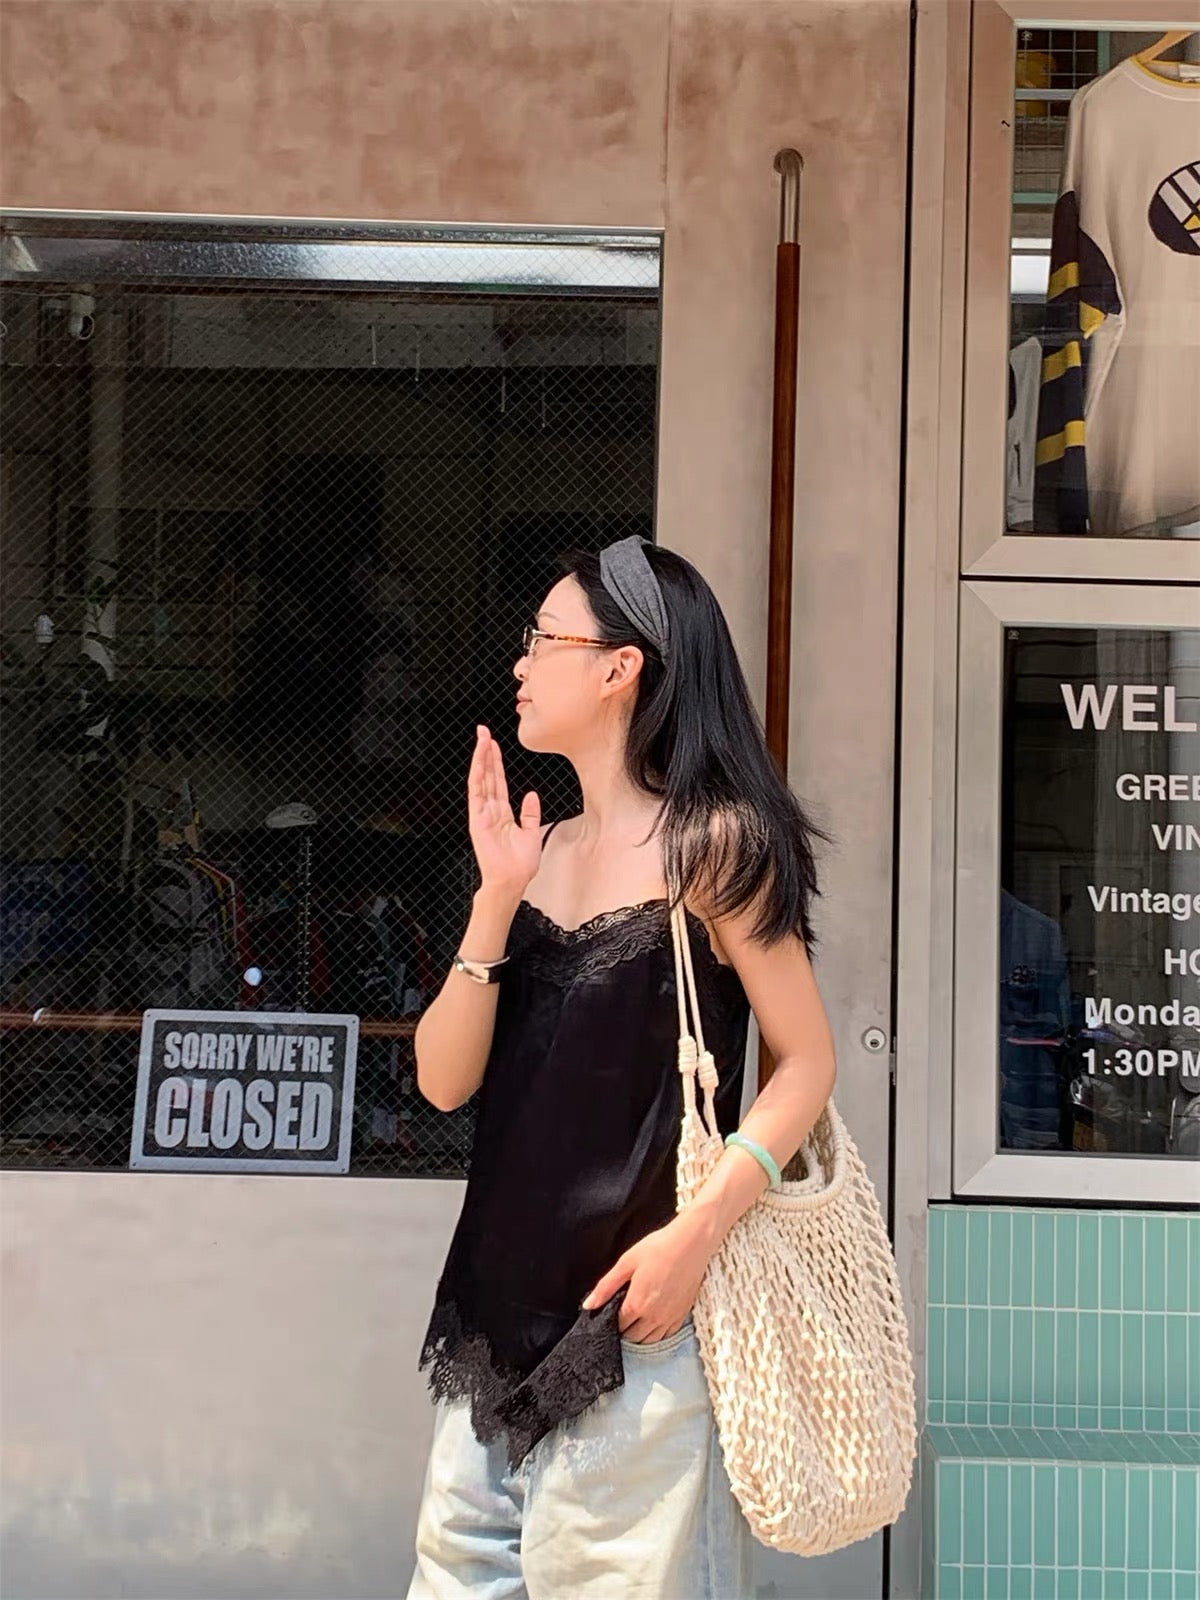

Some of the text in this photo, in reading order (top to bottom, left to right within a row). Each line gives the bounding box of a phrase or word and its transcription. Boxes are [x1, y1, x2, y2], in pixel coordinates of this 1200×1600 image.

[1060, 684, 1197, 732] WEL
[1084, 997, 1200, 1028] Monda
[163, 1031, 335, 1073] SORRY WE'RE
[1082, 1048, 1200, 1077] 1:30PM
[154, 1076, 334, 1151] CLOSED
